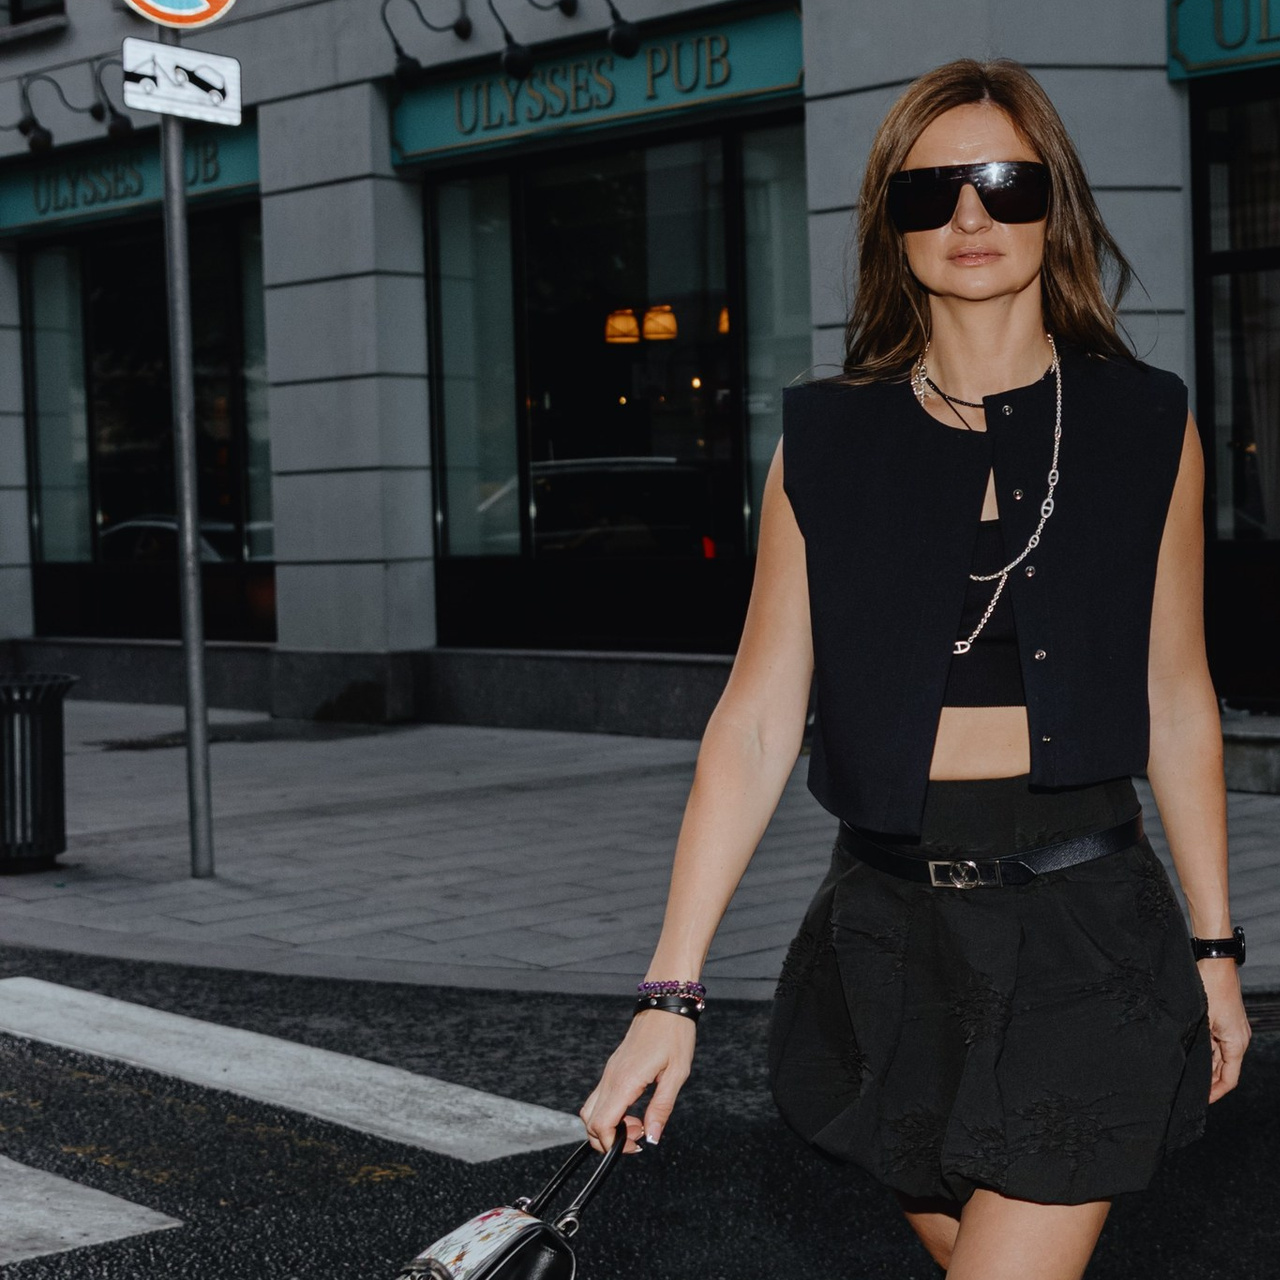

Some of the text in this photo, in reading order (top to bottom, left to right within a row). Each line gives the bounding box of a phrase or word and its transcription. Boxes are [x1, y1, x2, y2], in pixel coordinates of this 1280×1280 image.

[453, 33, 731, 135] ULYSSES PUB
[33, 138, 221, 215] ULYSSES UB
